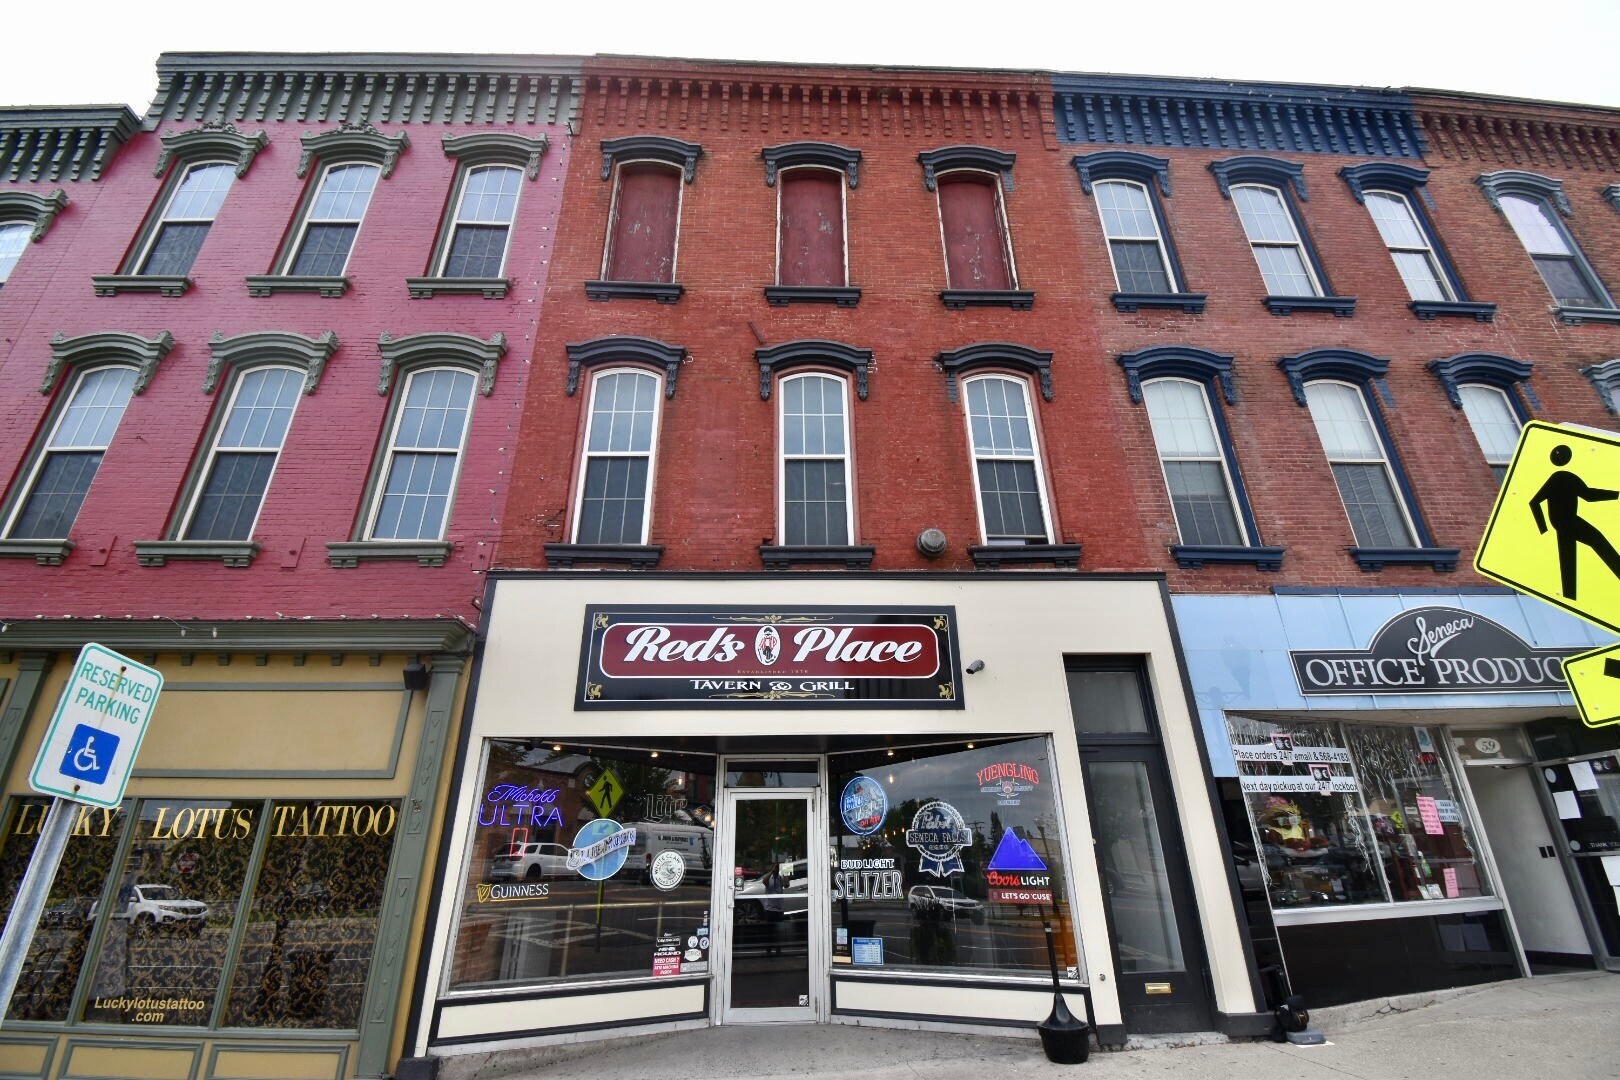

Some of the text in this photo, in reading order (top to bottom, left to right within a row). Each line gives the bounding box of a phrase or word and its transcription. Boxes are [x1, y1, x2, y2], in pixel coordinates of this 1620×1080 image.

[622, 624, 923, 663] Red's Place
[1407, 616, 1475, 667] Seneca
[1305, 656, 1568, 686] OFFICE PRODUC
[80, 661, 153, 703] RESERVED
[690, 679, 761, 690] TAVERN
[800, 681, 855, 691] GRILL
[75, 686, 141, 725] PARKING
[1481, 740, 1496, 751] 59
[1233, 749, 1254, 760] Place
[1254, 750, 1278, 760] orders
[1294, 751, 1313, 761] email
[1313, 752, 1319, 761] &
[976, 762, 1040, 785] YUENGLING
[1259, 781, 1272, 793] day
[1273, 781, 1297, 793] pickup
[1296, 782, 1304, 791] at
[1305, 783, 1316, 791] our
[1331, 781, 1358, 791] lockbox
[150, 807, 254, 840] LOTUS
[271, 804, 396, 837] TATTOO
[479, 804, 563, 827] ULTRA
[909, 832, 939, 843] SENECA
[841, 858, 895, 870] BUD LIGHT
[835, 869, 904, 900] SELTZER
[986, 870, 1050, 887] Coors LIGHT
[490, 883, 549, 899] GUINNESS
[1001, 892, 1018, 900] LET'S
[94, 995, 205, 1012] Luckylotustattoo
[131, 1012, 165, 1023] .com
